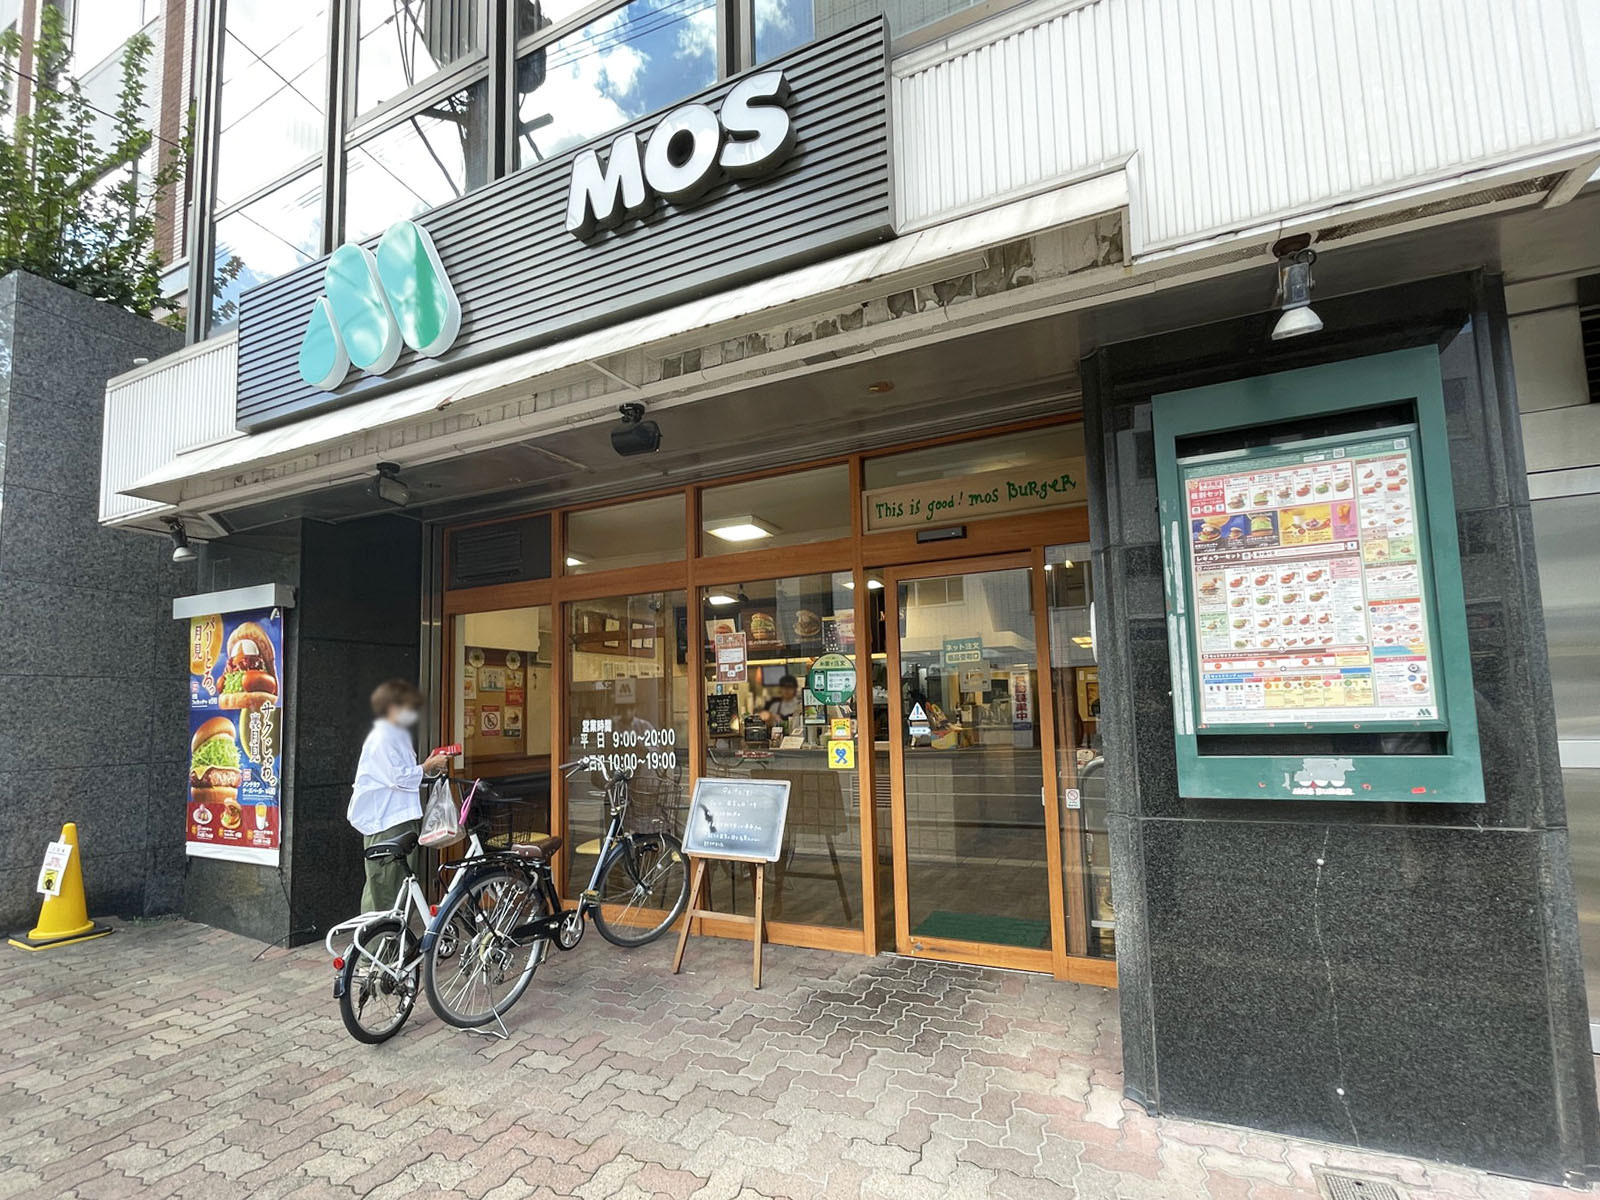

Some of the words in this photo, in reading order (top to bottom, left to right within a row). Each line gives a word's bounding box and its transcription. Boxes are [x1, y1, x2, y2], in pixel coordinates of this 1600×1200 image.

[565, 70, 792, 233] MOS
[875, 503, 903, 519] This
[910, 500, 920, 515] is
[194, 625, 203, 660] 月見
